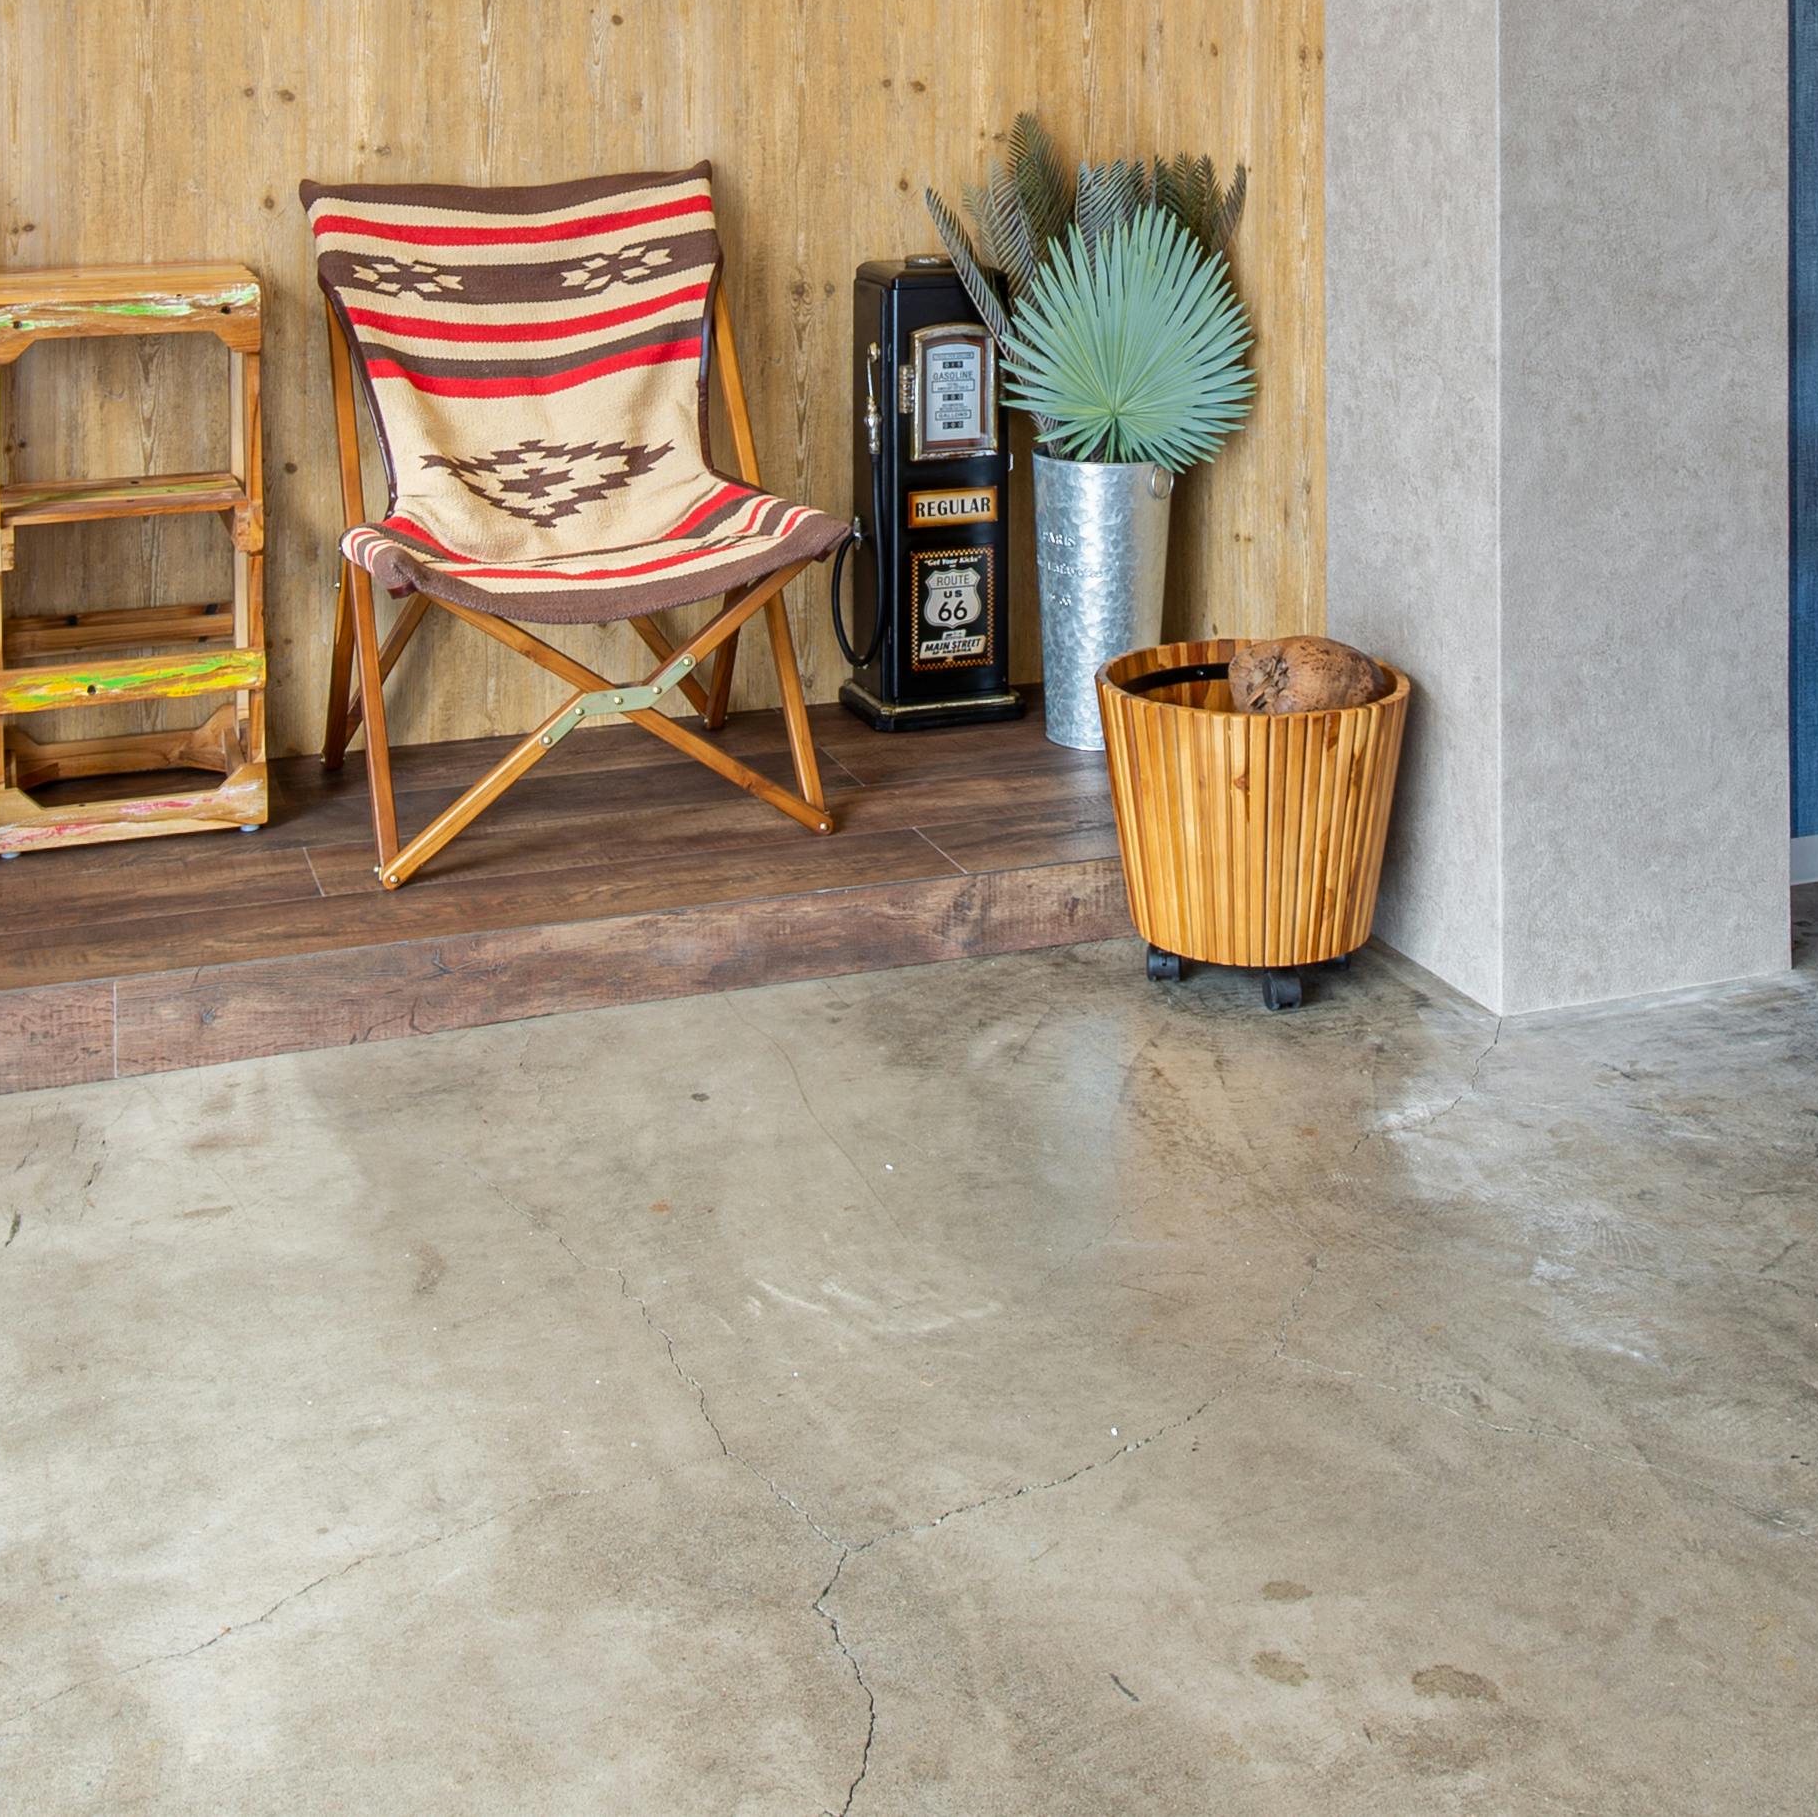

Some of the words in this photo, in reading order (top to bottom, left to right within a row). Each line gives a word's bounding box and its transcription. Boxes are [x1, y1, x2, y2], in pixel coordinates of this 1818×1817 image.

[933, 369, 973, 382] GASOLINE
[915, 496, 991, 518] REGULAR
[936, 574, 970, 587] ROUTE
[943, 589, 963, 598] US
[938, 599, 968, 622] 66
[924, 641, 951, 652] MAIN
[952, 638, 981, 650] STREET
